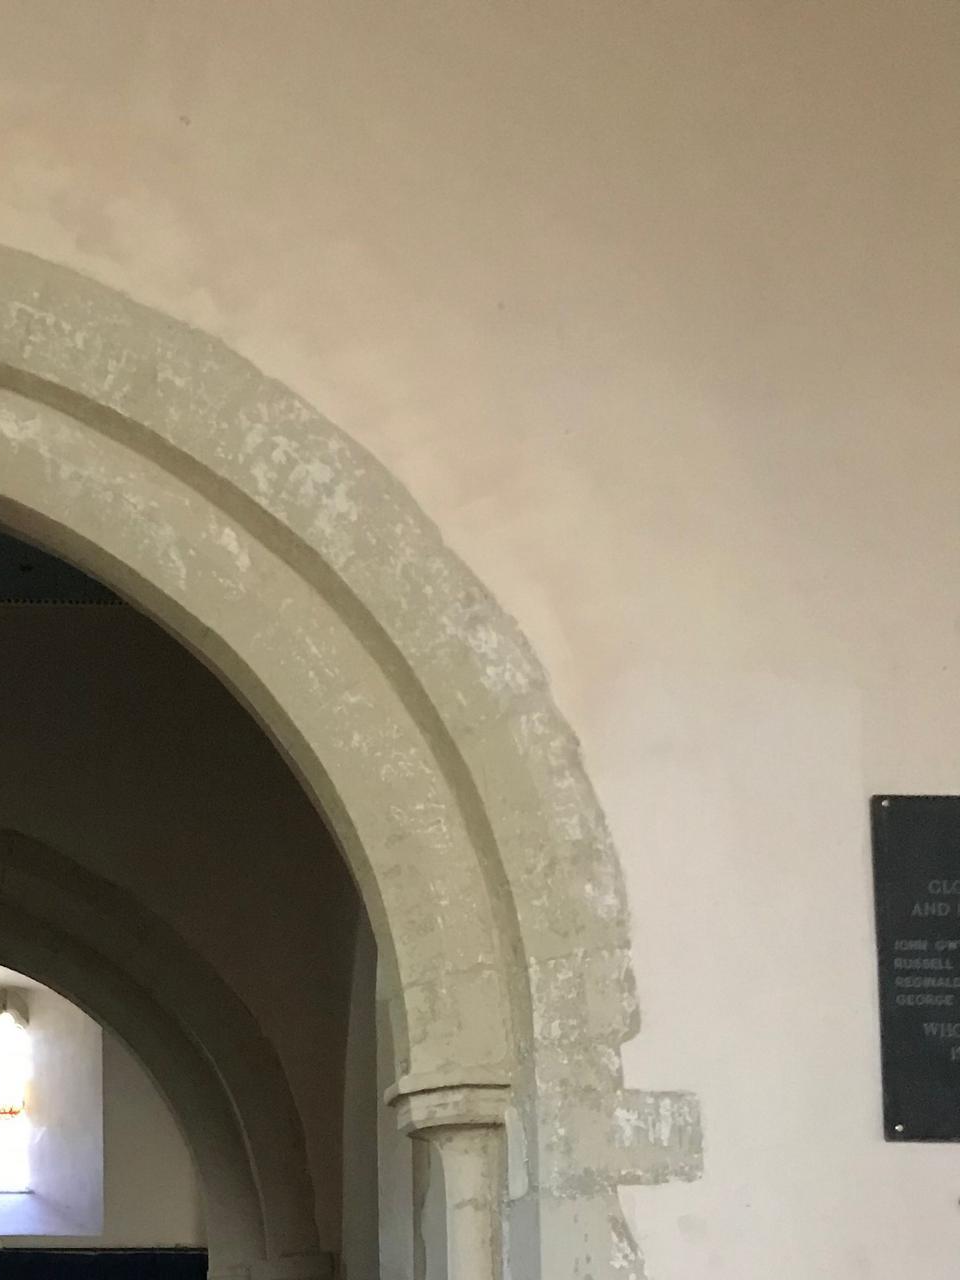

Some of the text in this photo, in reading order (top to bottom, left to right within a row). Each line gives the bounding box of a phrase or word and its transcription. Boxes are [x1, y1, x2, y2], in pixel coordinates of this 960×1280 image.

[911, 902, 951, 917] AND
[894, 958, 954, 970] RUSSELL
[895, 994, 954, 1007] GEORGE
